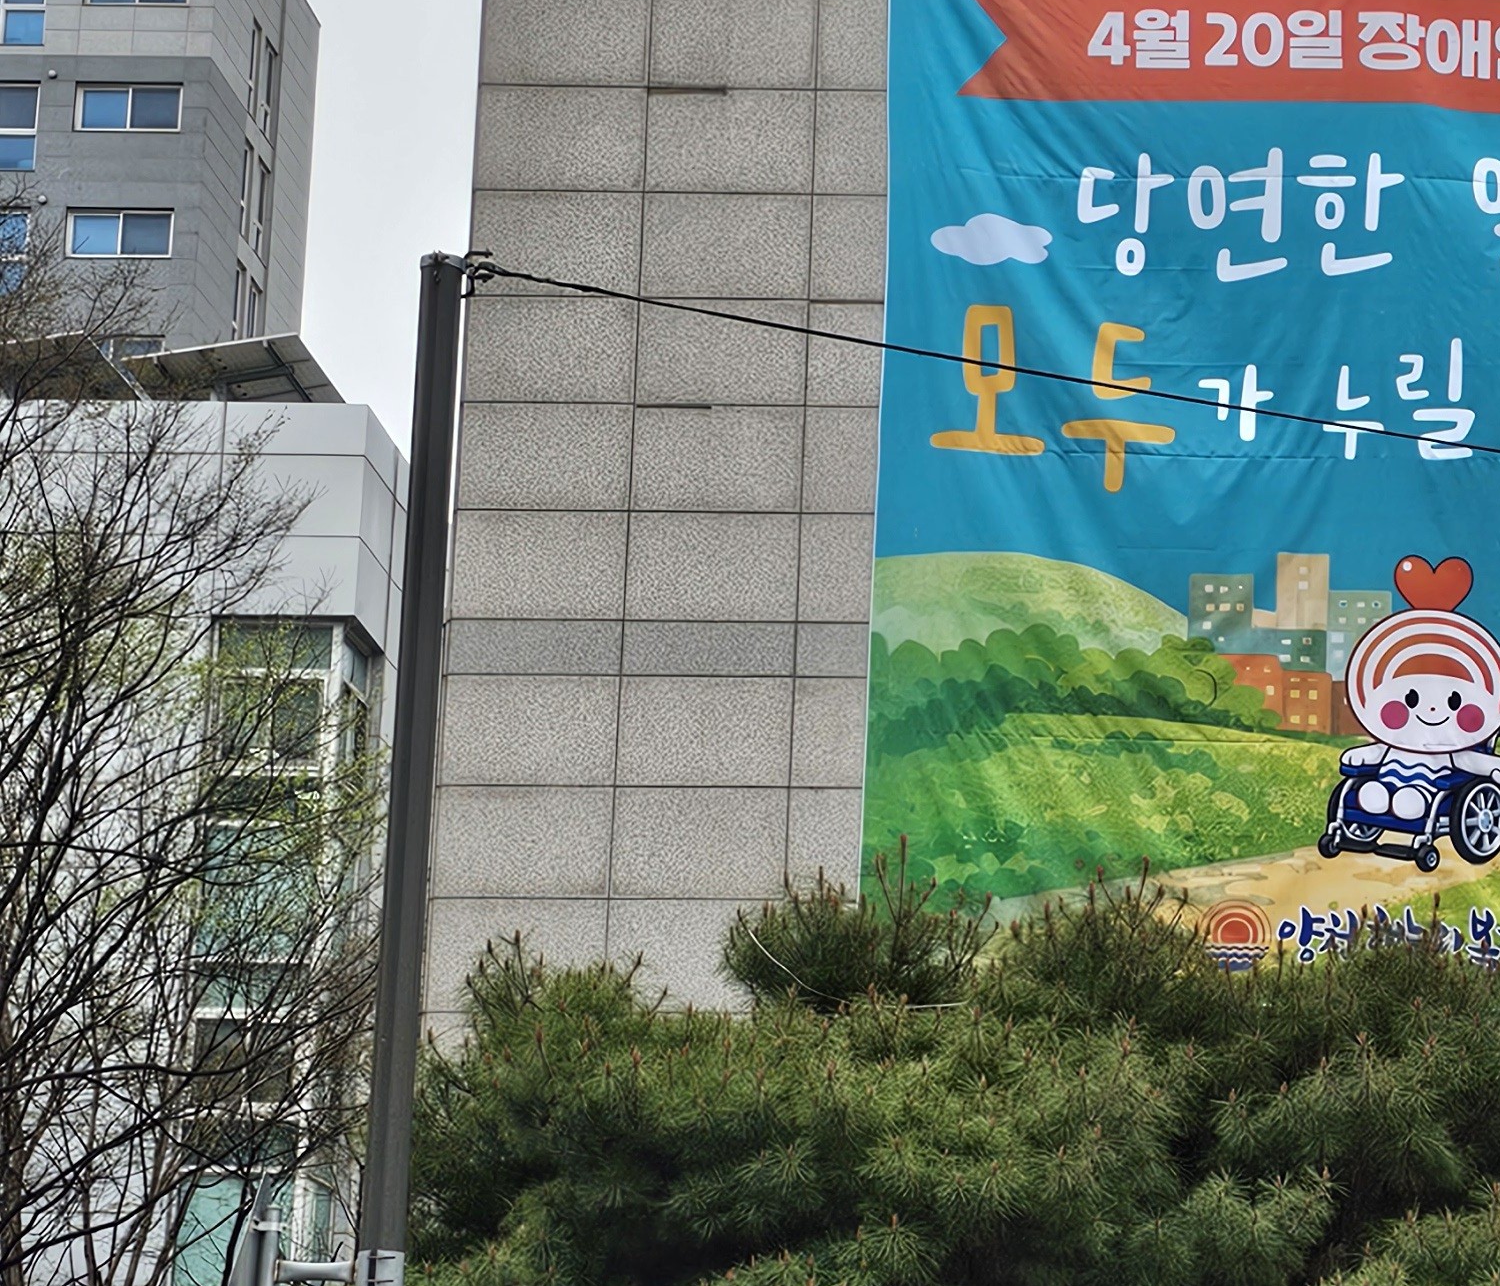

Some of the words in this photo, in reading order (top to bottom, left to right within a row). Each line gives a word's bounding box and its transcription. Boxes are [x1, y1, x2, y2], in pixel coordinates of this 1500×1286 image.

[1087, 9, 1191, 69] 4월
[1204, 9, 1343, 69] 20일
[1077, 147, 1405, 282] 당연한
[1322, 337, 1476, 461] 누릴
